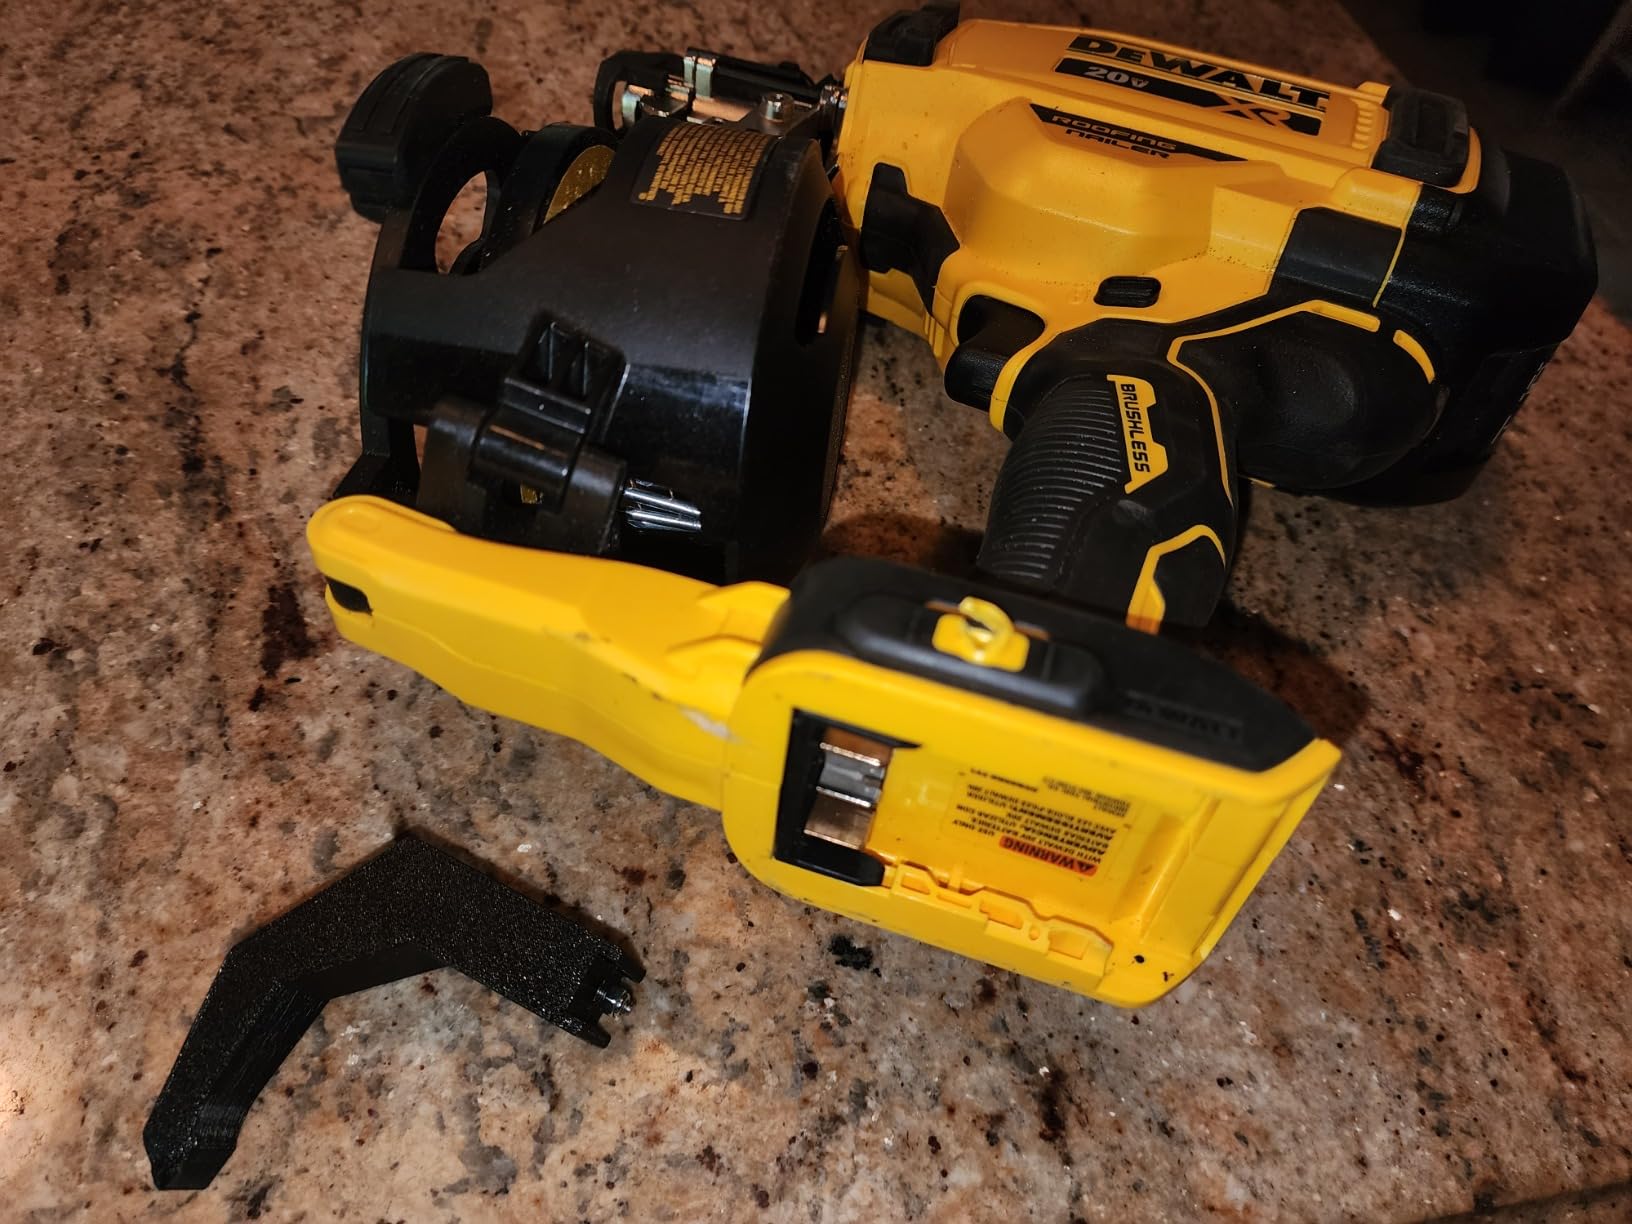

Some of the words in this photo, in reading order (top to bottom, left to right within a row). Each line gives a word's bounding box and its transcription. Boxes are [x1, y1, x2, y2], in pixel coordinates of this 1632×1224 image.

[1067, 35, 1330, 112] DEWALT
[1210, 94, 1292, 128] XR
[1052, 115, 1176, 150] ROOFING
[1066, 128, 1170, 160] NAILER
[1120, 383, 1151, 473] BRUSHLESS
[1001, 837, 1076, 868] WARNING
[1075, 851, 1102, 864] WITH
